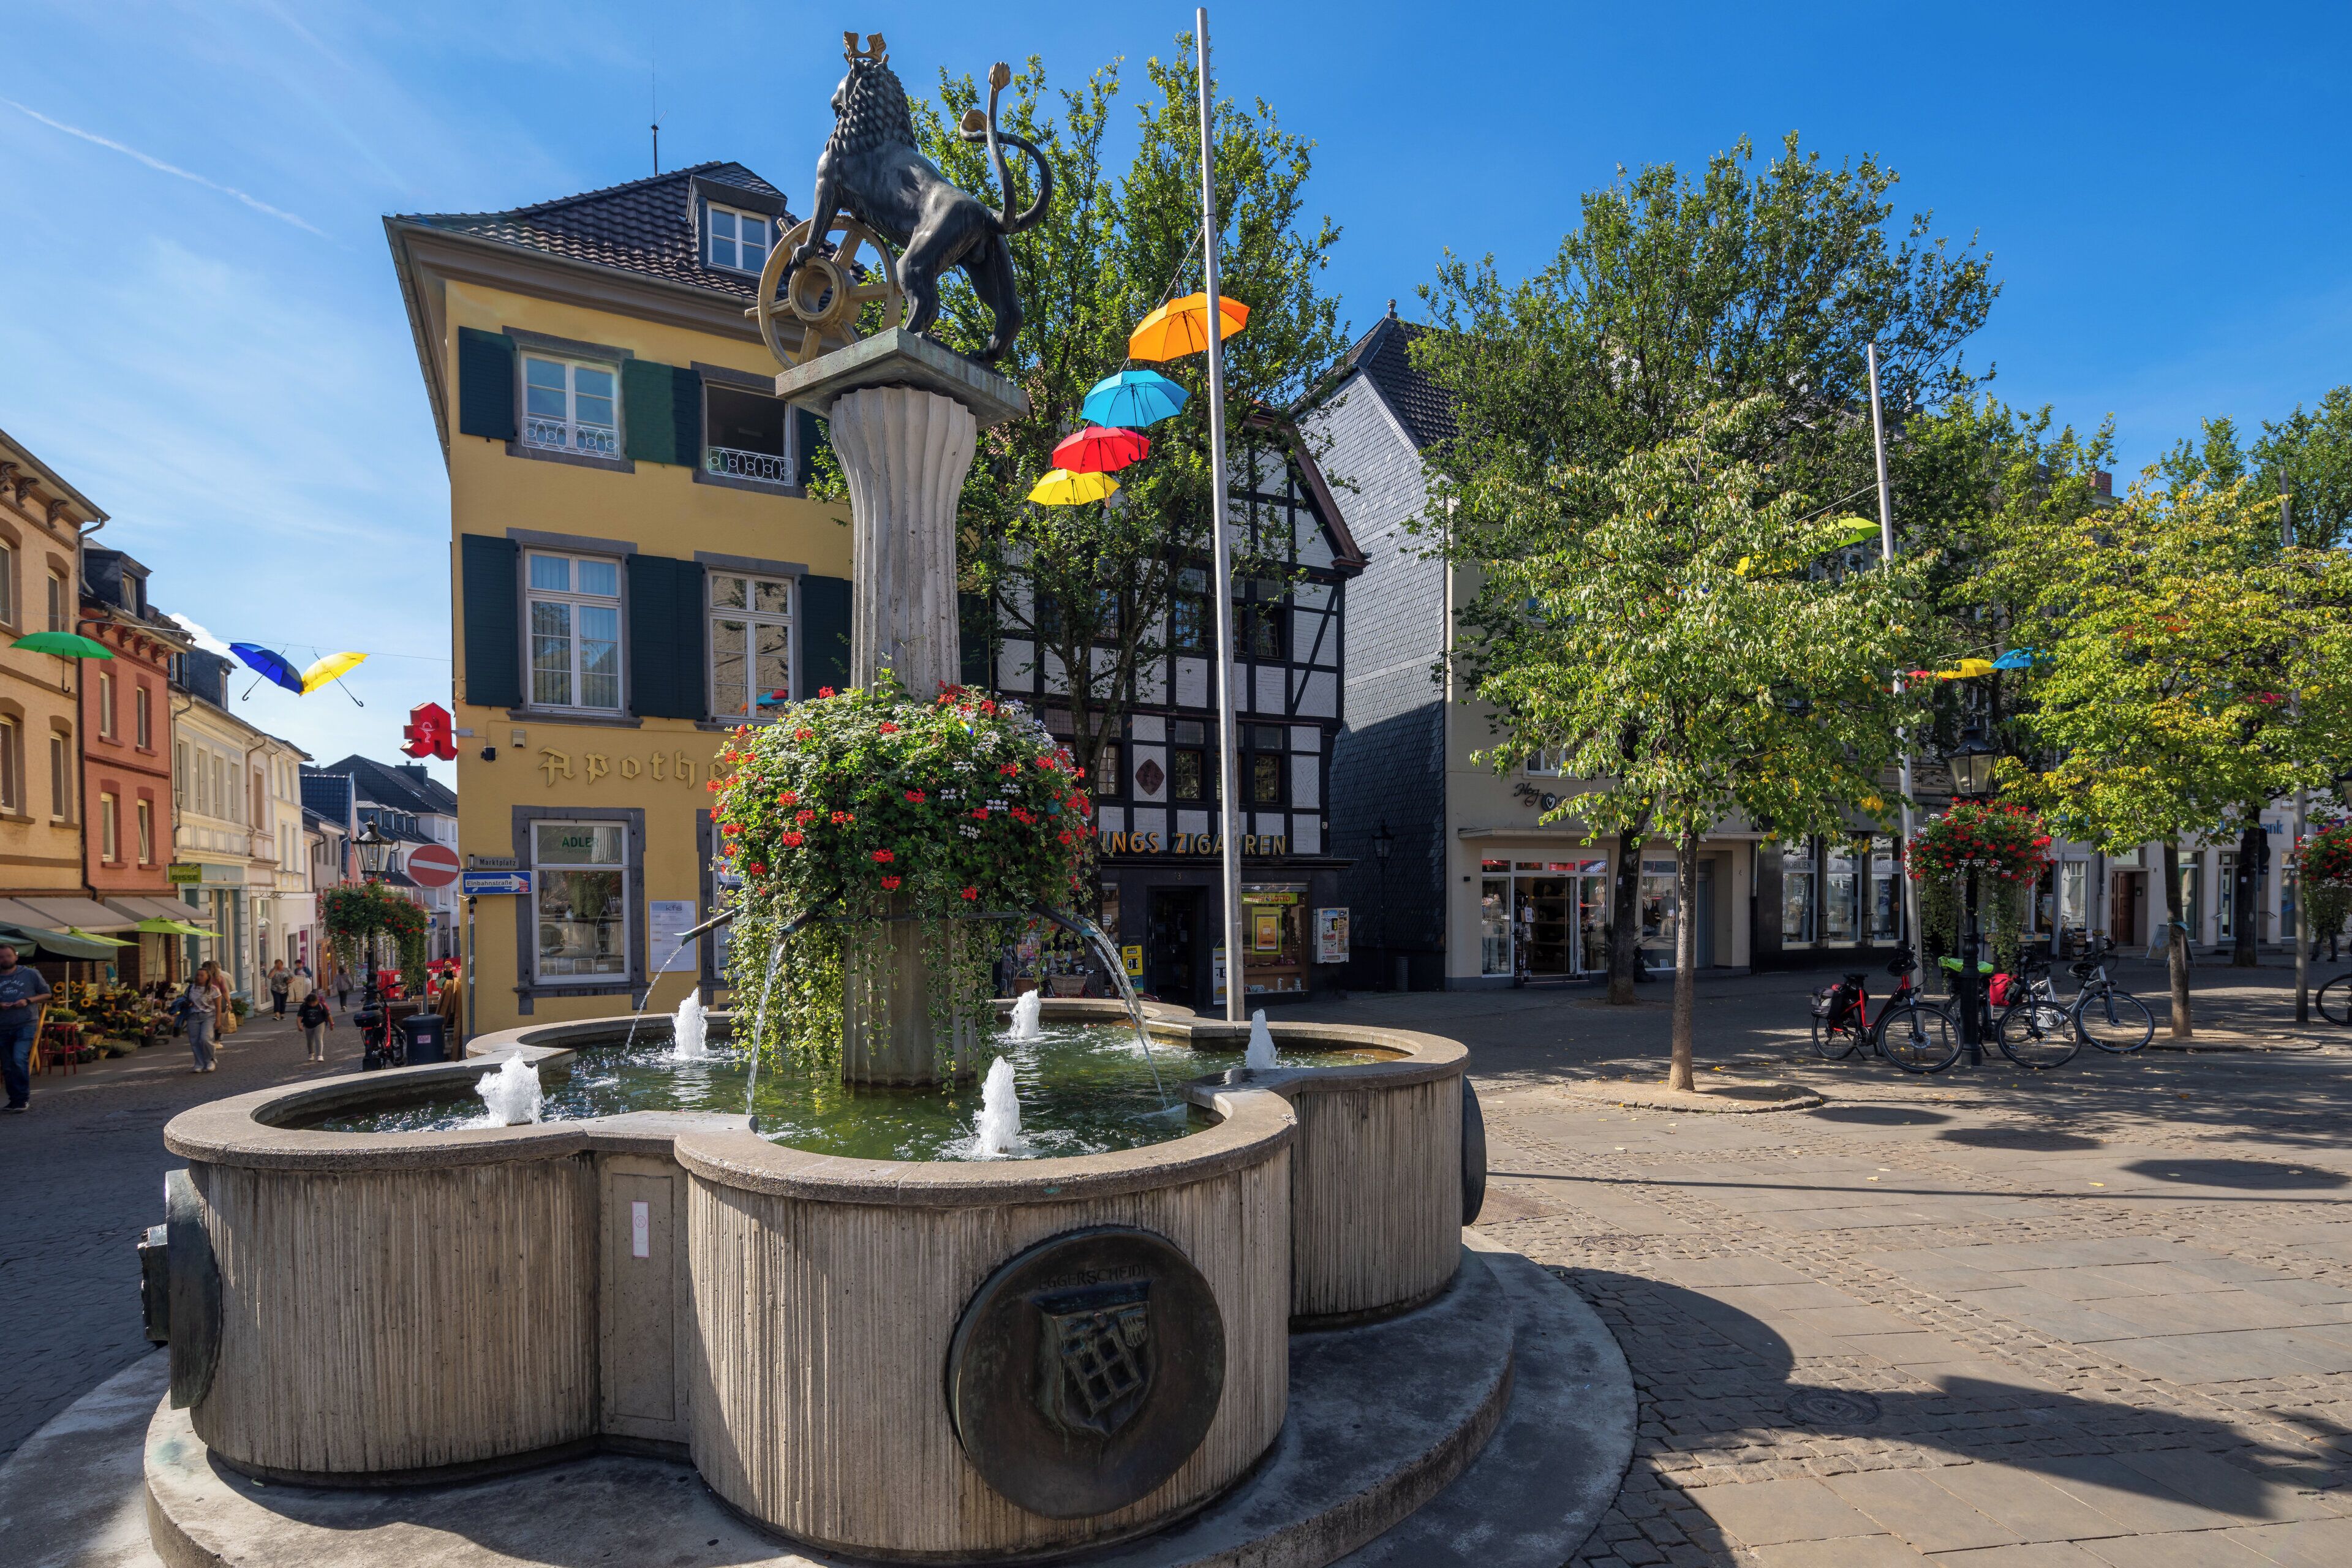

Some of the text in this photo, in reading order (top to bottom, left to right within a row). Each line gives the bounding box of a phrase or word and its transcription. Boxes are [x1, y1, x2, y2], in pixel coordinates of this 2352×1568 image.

[538, 747, 728, 789] Apothe
[1101, 831, 1286, 855] INGS ZIGAREN
[1783, 861, 1811, 869] MOBILIEN
